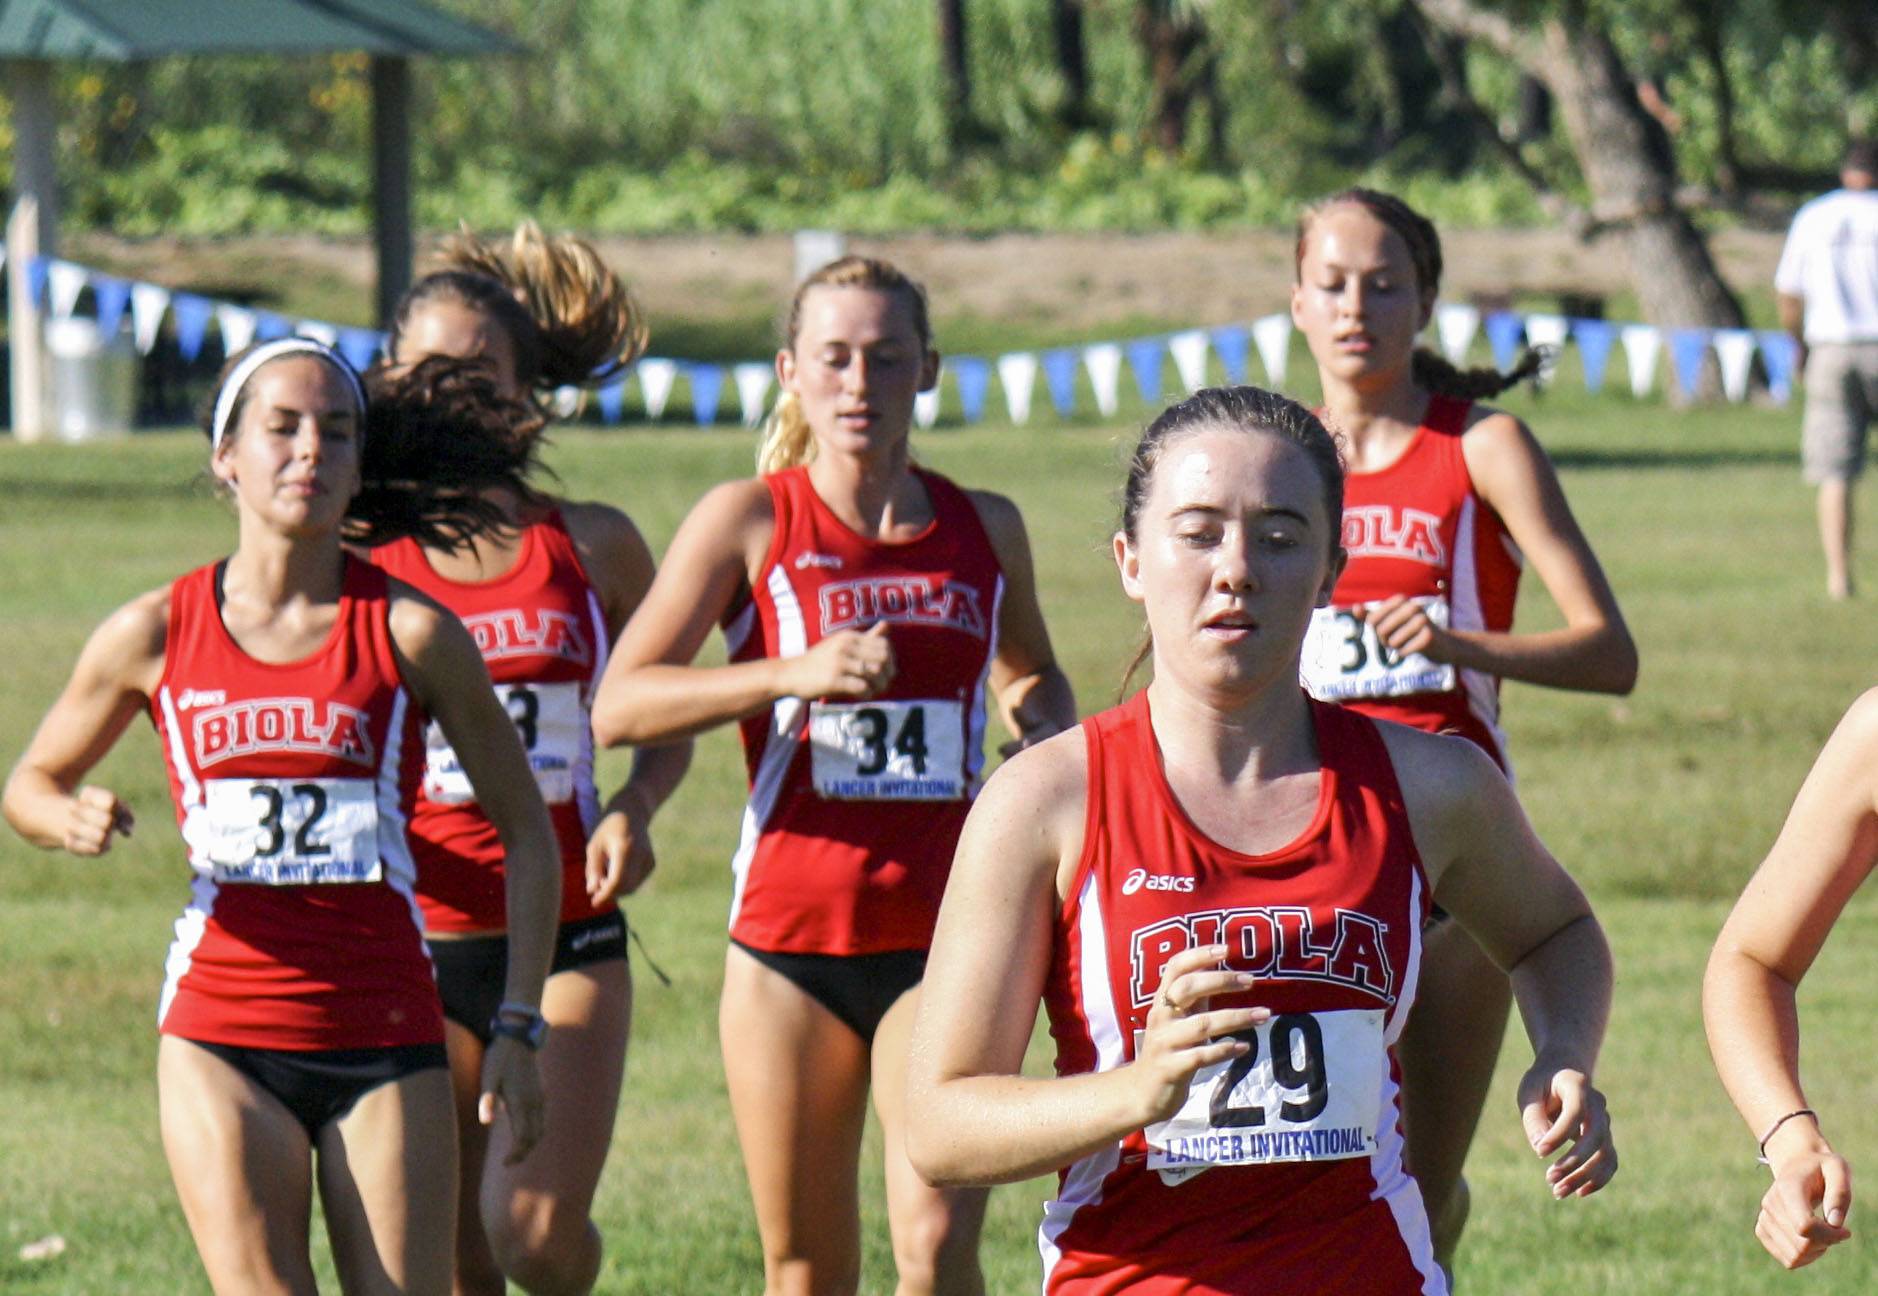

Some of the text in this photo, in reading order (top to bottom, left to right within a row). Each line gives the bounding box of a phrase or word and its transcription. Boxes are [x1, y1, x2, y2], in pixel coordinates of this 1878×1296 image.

[1338, 504, 1446, 569] OLA
[462, 608, 590, 666] OLA
[819, 575, 987, 641] BIOLA
[193, 696, 374, 770] BIOLA
[856, 707, 929, 776] 34
[249, 784, 331, 856] 32
[1145, 874, 1195, 893] asics
[1129, 906, 1394, 1009] BIOLA
[1208, 1012, 1329, 1129] 29
[1165, 1126, 1366, 1164] LANCER INVITATIONAL
